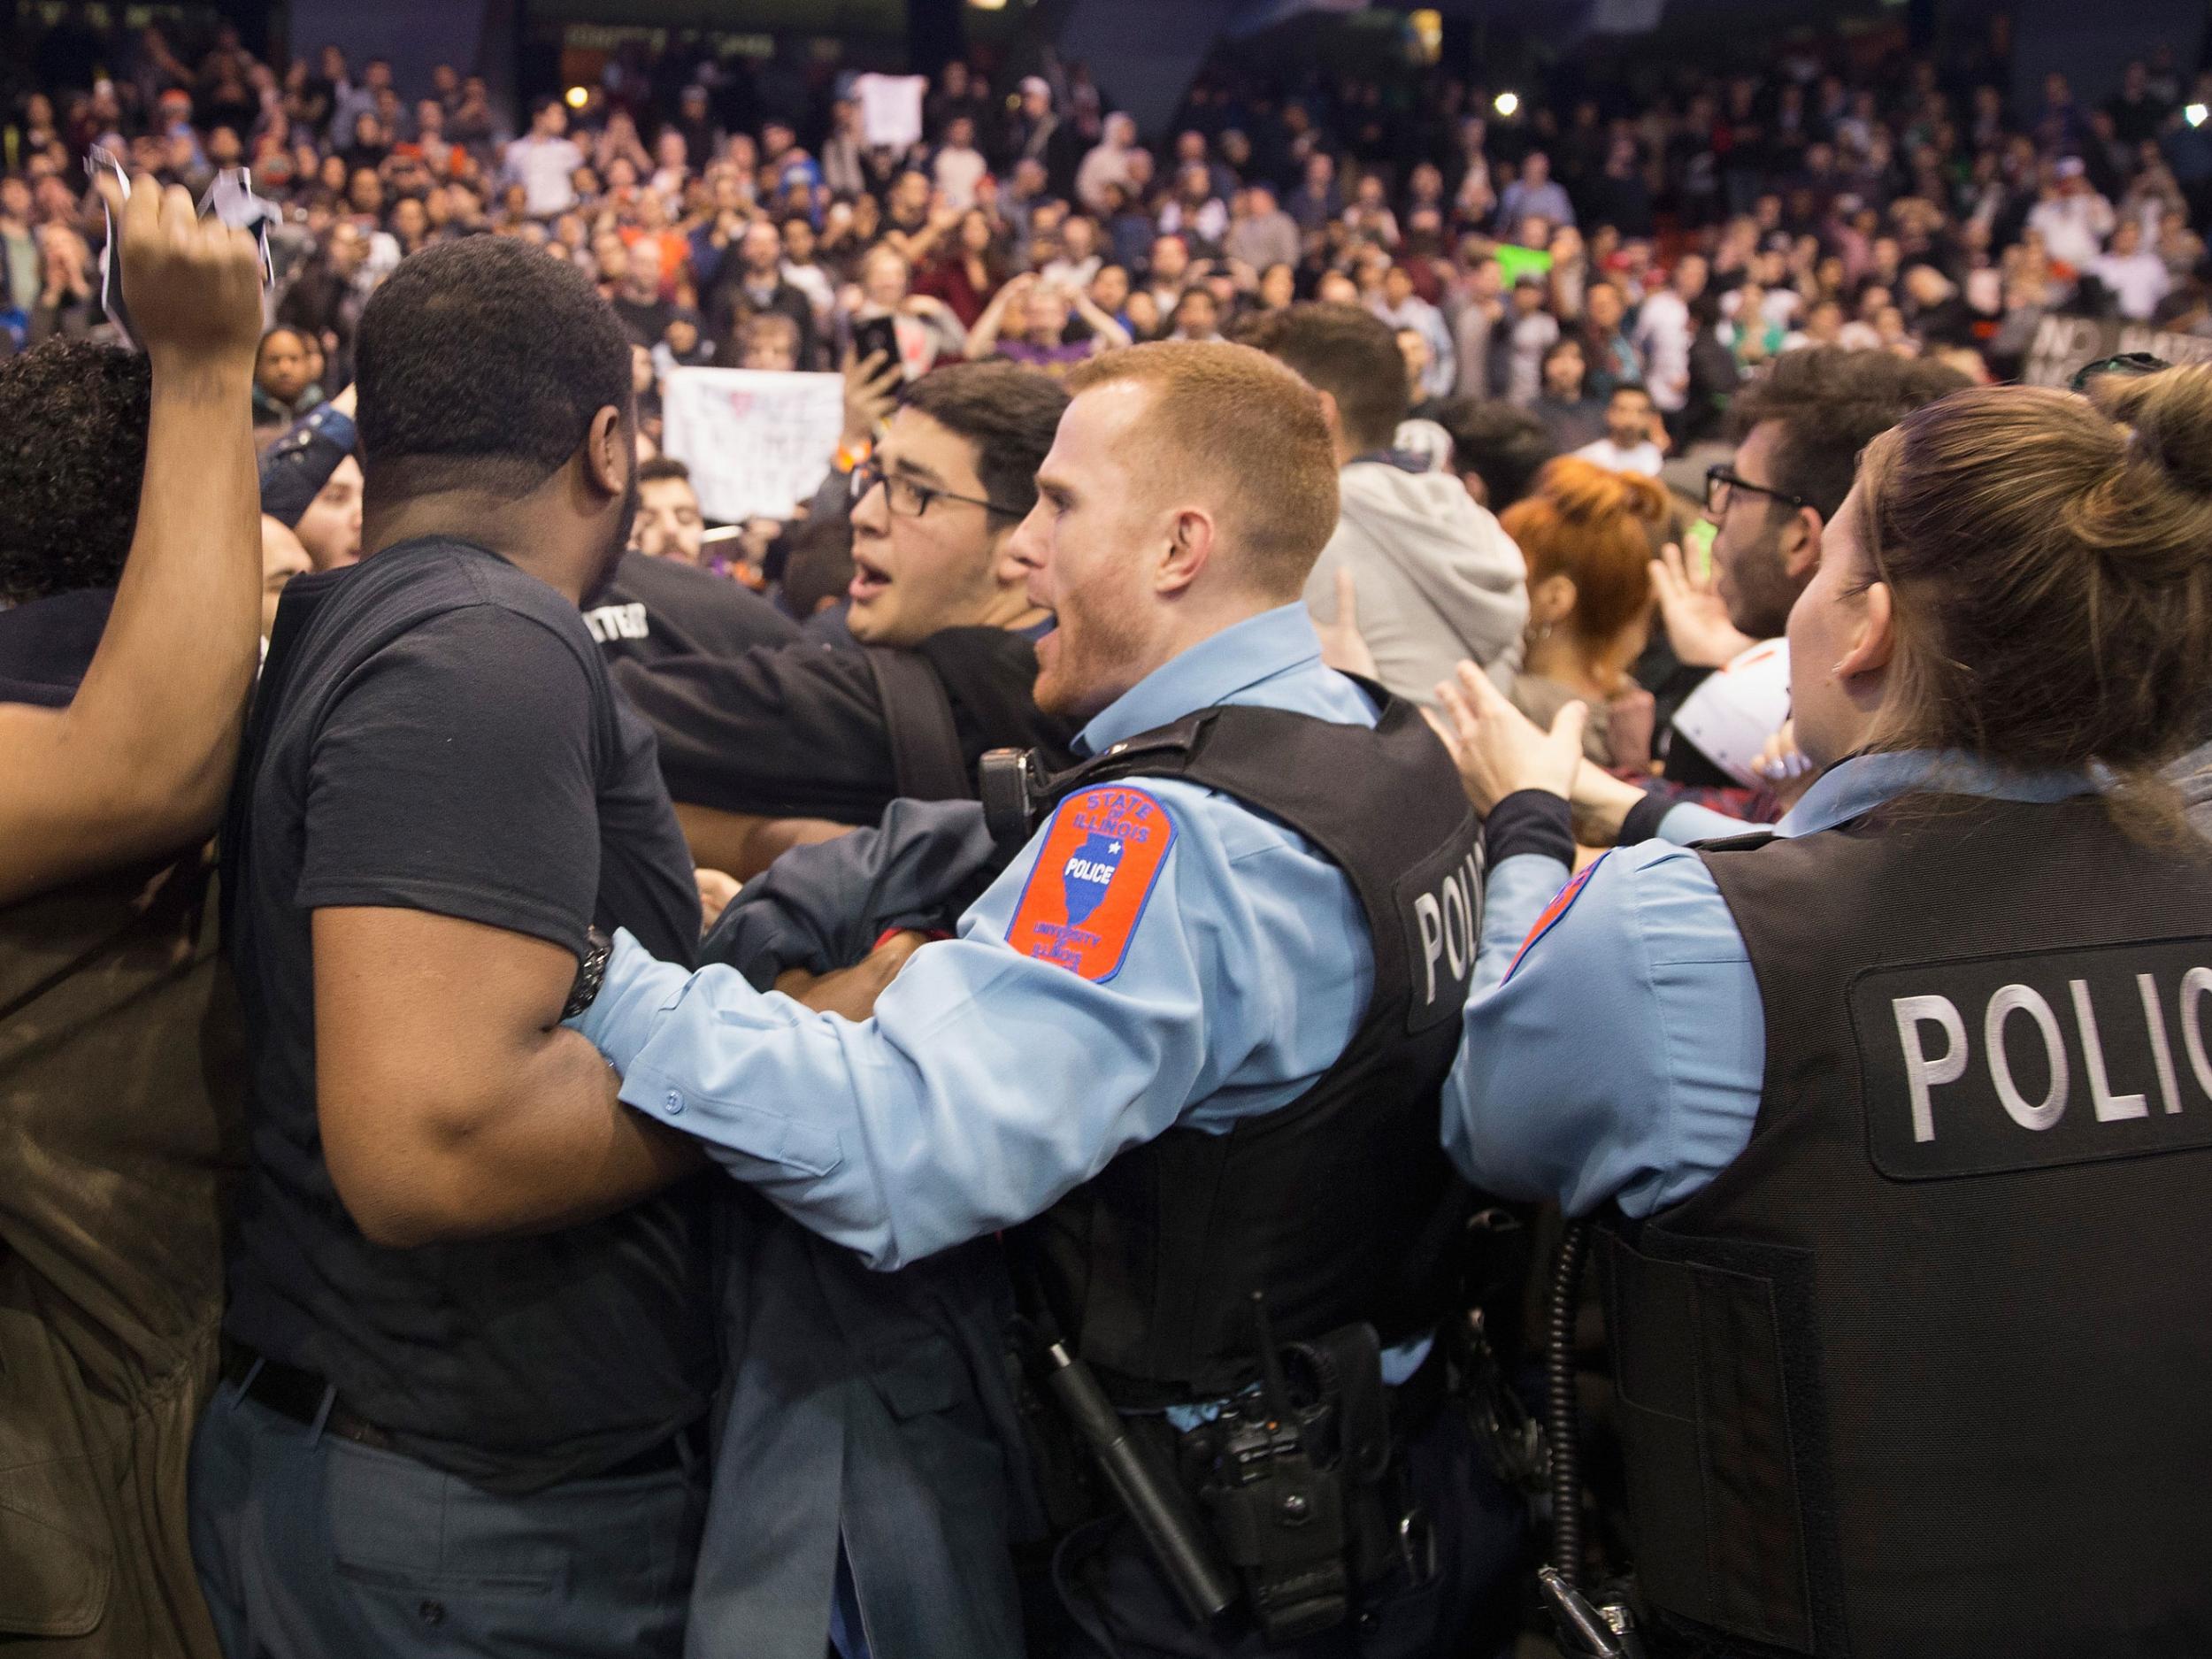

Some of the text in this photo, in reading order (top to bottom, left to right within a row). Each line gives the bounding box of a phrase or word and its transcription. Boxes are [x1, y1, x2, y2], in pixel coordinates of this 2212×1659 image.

[1087, 793, 1154, 821] STATE
[1073, 813, 1150, 842] ILLINOIS
[1064, 857, 1116, 885] POLICE
